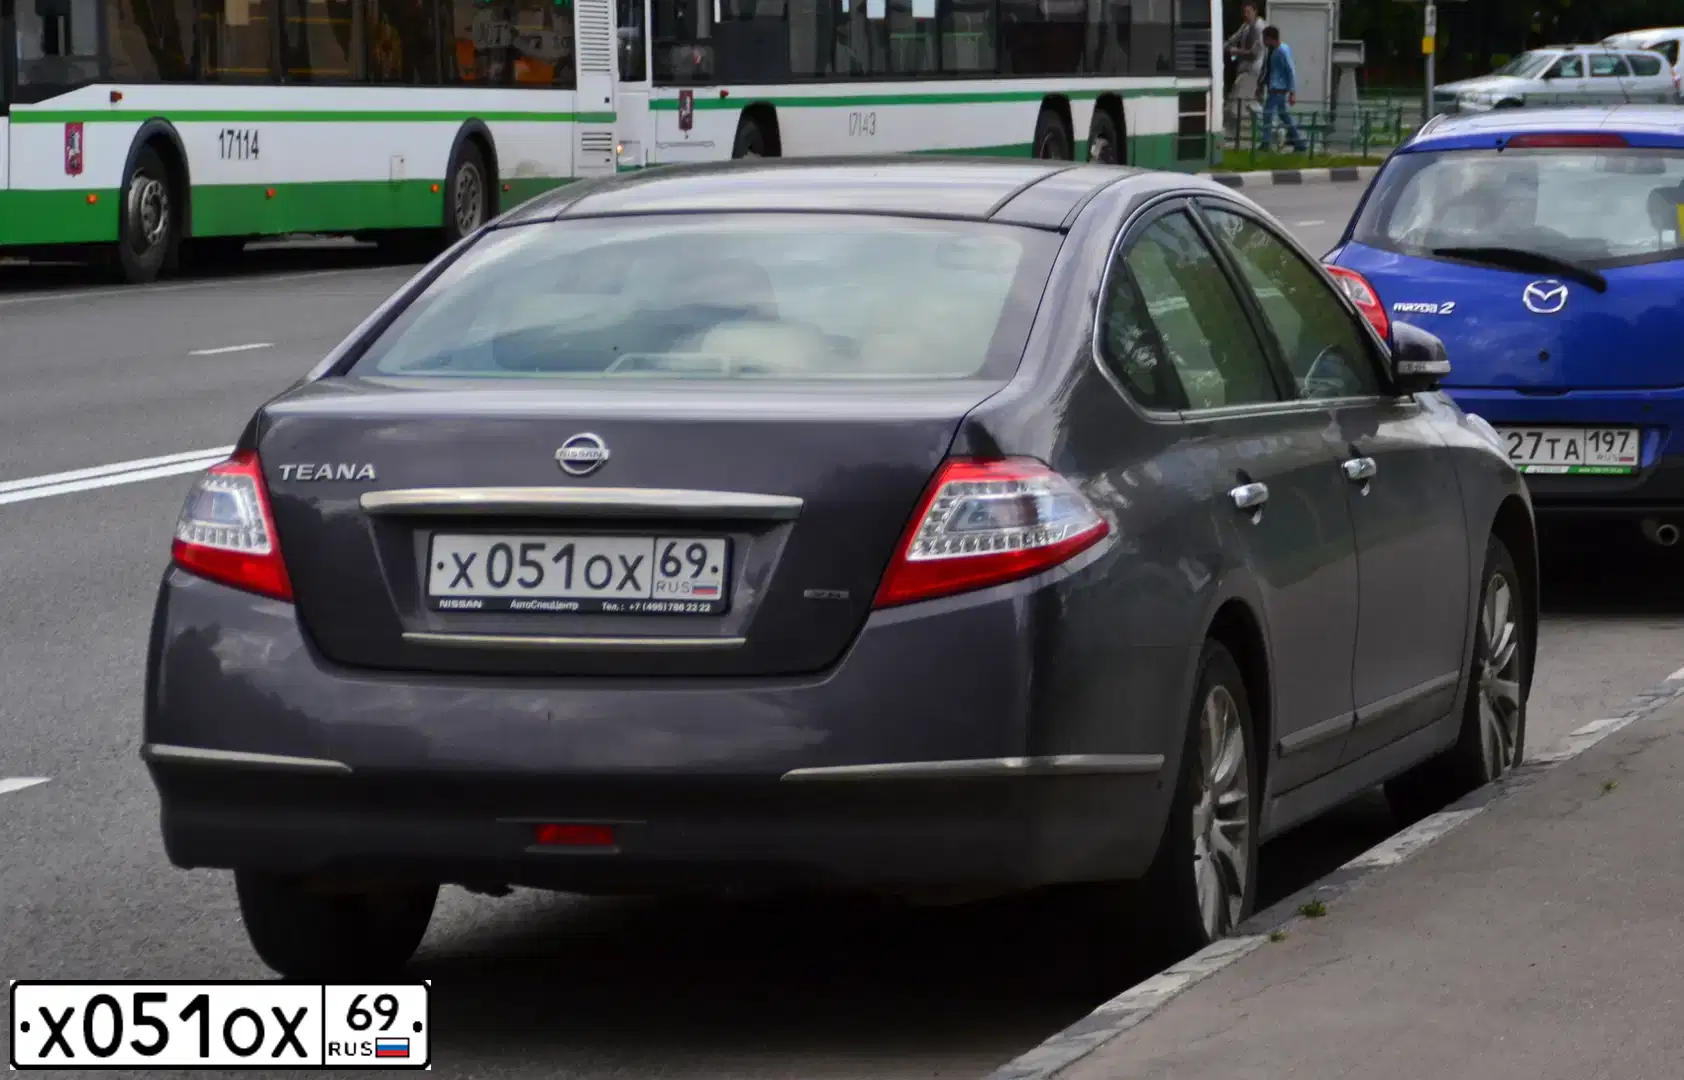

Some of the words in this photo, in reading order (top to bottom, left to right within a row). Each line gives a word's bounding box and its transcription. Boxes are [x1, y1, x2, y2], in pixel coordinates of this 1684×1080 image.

[849, 111, 876, 137] 17143
[219, 128, 259, 160] 17114
[1439, 301, 1456, 315] 2
[1497, 430, 1580, 460] 27ТА
[1588, 430, 1631, 453] 197
[559, 450, 604, 458] NISSAN
[278, 463, 376, 480] TEANA
[659, 541, 707, 579] 69
[656, 581, 690, 593] RUS
[440, 600, 482, 608] NISSAN
